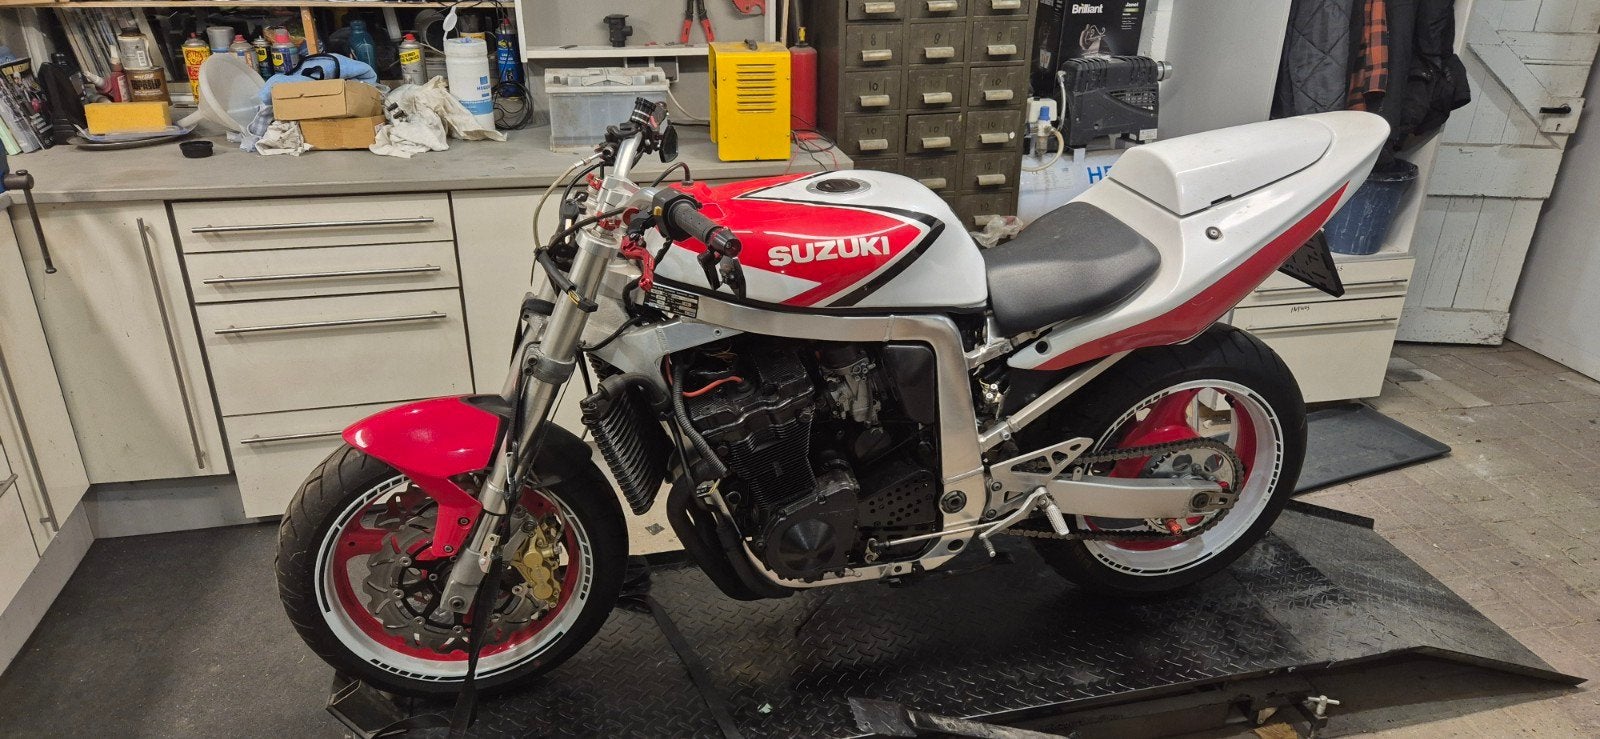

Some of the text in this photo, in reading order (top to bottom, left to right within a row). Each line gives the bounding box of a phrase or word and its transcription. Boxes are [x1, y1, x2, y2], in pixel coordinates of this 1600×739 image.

[1072, 3, 1103, 14] Brilliant
[870, 33, 877, 46] 8
[868, 82, 879, 91] 10
[991, 78, 1002, 87] 10
[866, 127, 877, 136] 10
[928, 126, 940, 134] 10
[984, 161, 993, 170] 12
[768, 236, 890, 267] SUZUKI
